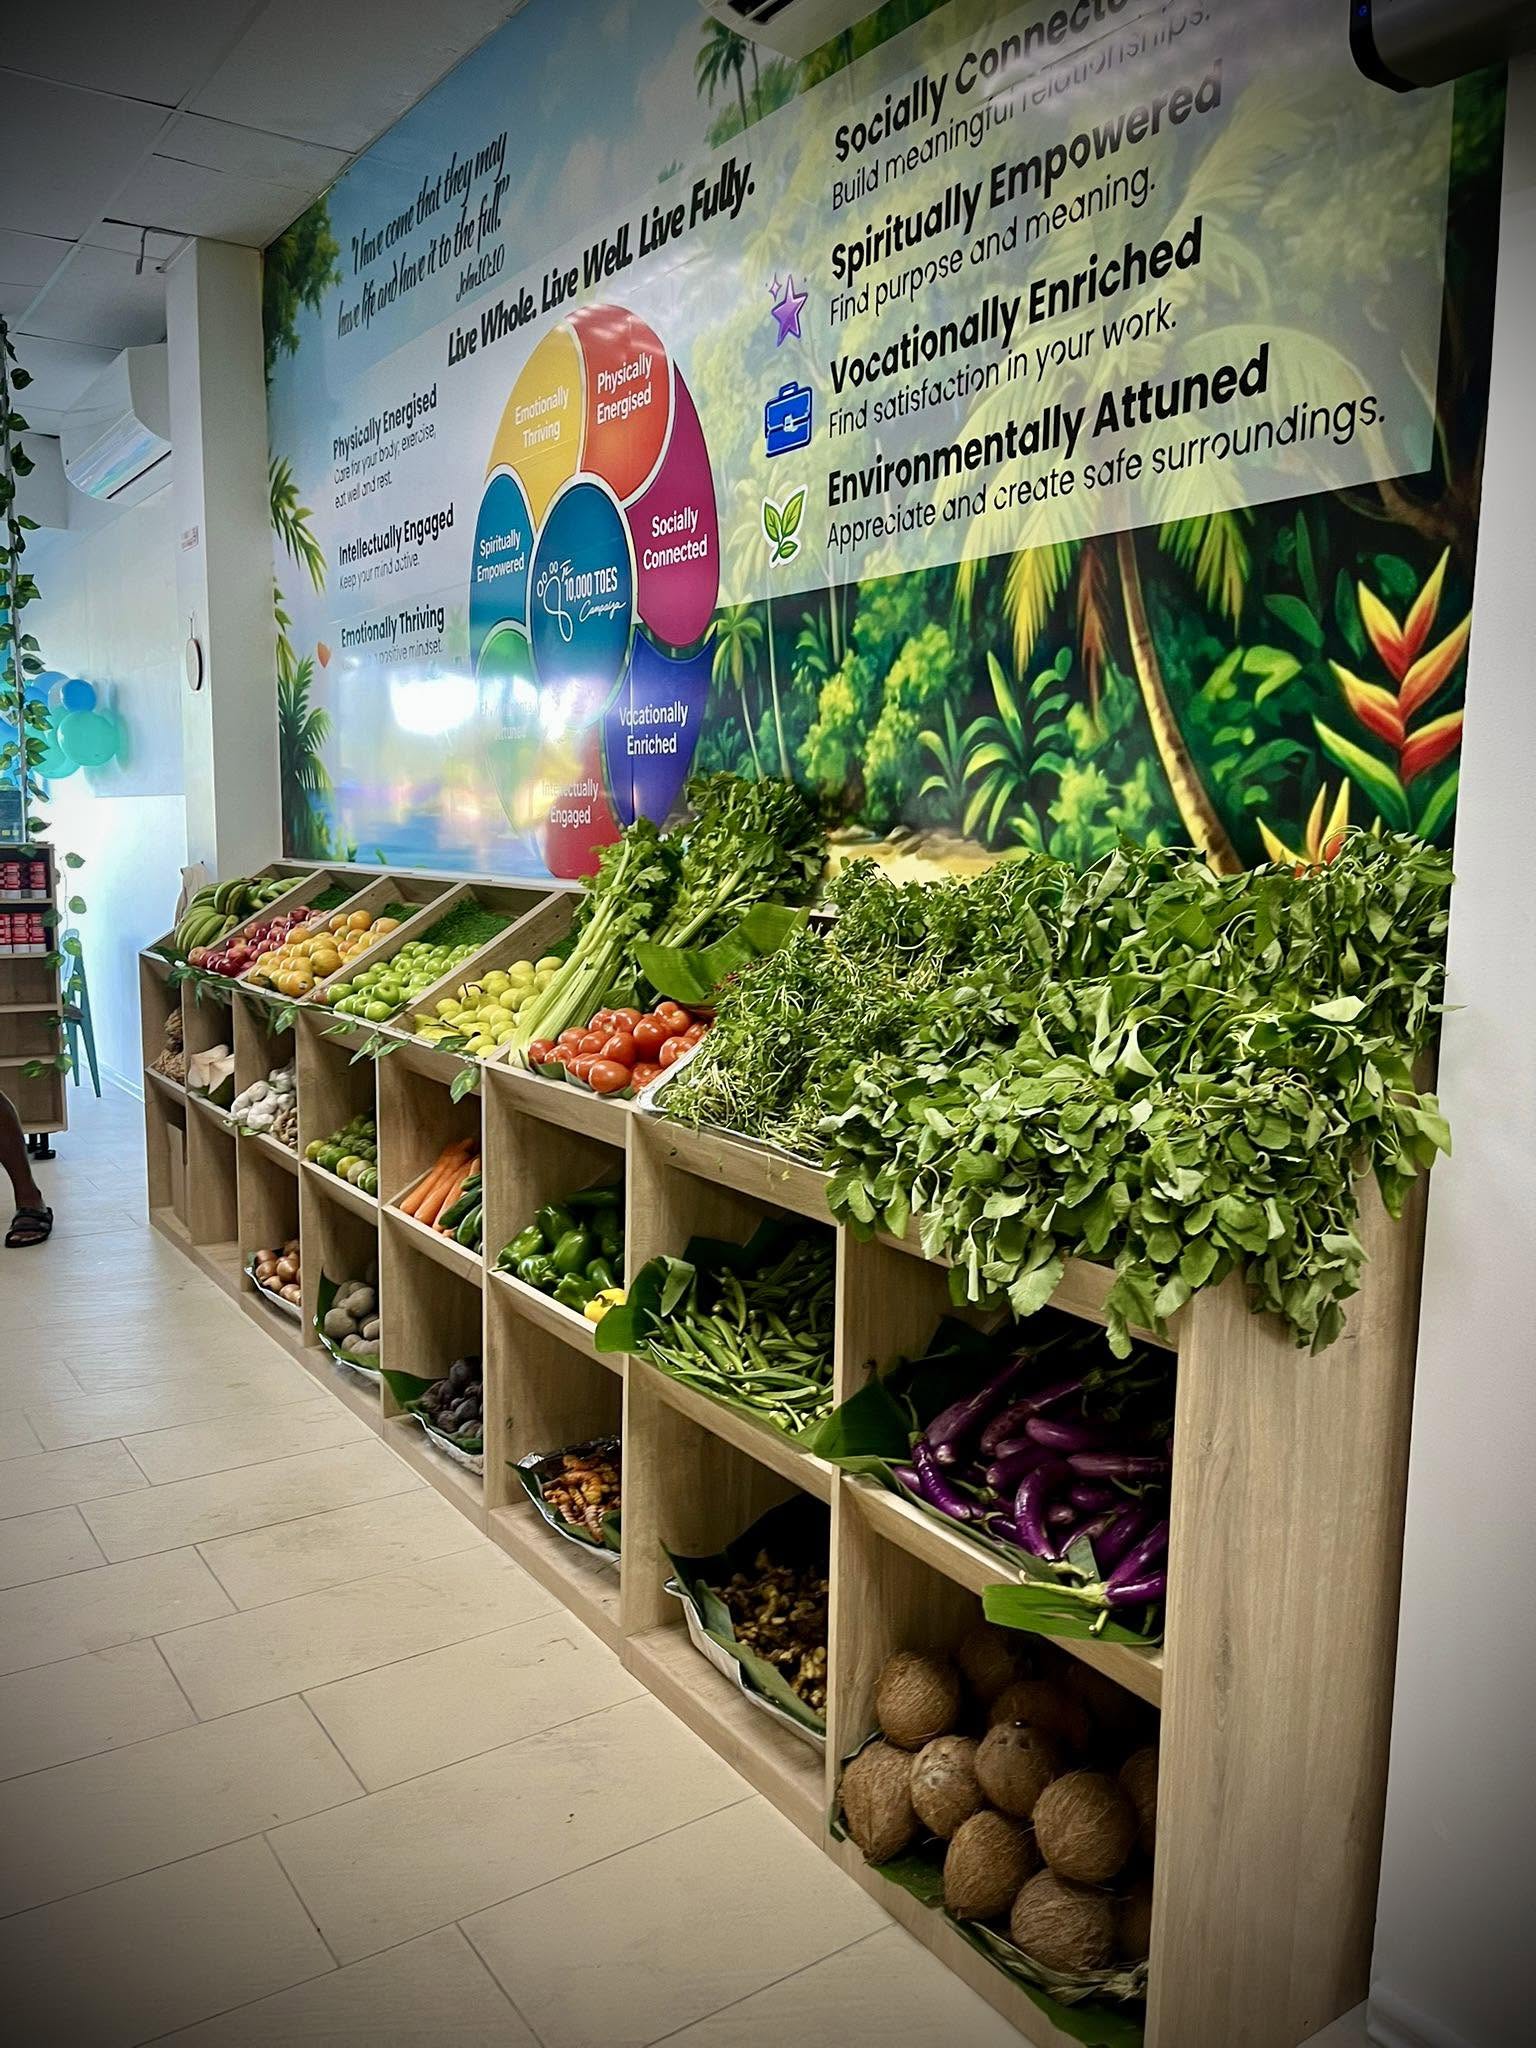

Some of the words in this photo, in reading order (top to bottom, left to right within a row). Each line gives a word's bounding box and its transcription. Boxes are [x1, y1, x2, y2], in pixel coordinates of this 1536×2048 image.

[835, 73, 948, 162] Socially
[832, 161, 880, 210] Build
[886, 86, 1014, 182] meaningful
[832, 176, 983, 287] Spiritually
[990, 59, 1223, 209] Empowered
[360, 228, 383, 270] have
[385, 205, 414, 249] come
[417, 175, 441, 225] that
[444, 152, 473, 207] they
[474, 132, 507, 182] may
[448, 327, 477, 367] Live
[481, 287, 537, 348] Whole.
[541, 267, 578, 314] Live
[583, 222, 634, 289] Well.
[639, 206, 685, 258] Live
[689, 156, 755, 230] Fully.
[831, 283, 869, 326] Find
[876, 245, 963, 317] purpose
[970, 216, 1018, 264] and
[1025, 166, 1156, 243] meaning.
[338, 299, 360, 340] have
[362, 279, 376, 330] life
[378, 260, 397, 311] and
[400, 252, 425, 296] have
[428, 238, 437, 275] it
[439, 233, 451, 268] to
[453, 206, 475, 257] the
[830, 295, 1021, 394] Vocationally
[1029, 216, 1203, 325] Enriched
[597, 351, 653, 394] Physically
[829, 400, 867, 438] Find
[873, 362, 999, 425] satisfaction
[1007, 349, 1028, 382] in
[1036, 328, 1095, 382] your
[1102, 297, 1177, 349] work.
[333, 417, 381, 461] Physically
[383, 383, 437, 433] Energised
[515, 385, 569, 425] Emotionally
[596, 382, 652, 425] Energised
[828, 404, 1086, 506] Environmentally
[1092, 342, 1270, 437] Attuned
[522, 420, 561, 448] Thriving
[827, 502, 936, 555] Appreciate
[943, 484, 987, 521] and
[994, 468, 1074, 510] create
[1083, 448, 1142, 490] safe
[1152, 395, 1385, 475] surroundings.
[339, 524, 402, 566] Intellectually
[404, 502, 454, 546] Engaged
[480, 528, 521, 559] Spiritually
[651, 506, 699, 538] Socially
[477, 551, 525, 583] Empowered
[643, 533, 708, 570] Connected
[340, 574, 356, 592] Keep
[564, 572, 593, 603] 10,000
[595, 566, 618, 595] TOES
[341, 615, 398, 648] Emotionally
[399, 604, 445, 633] Thriving
[619, 700, 688, 728] Vocationally
[627, 732, 677, 755] Enriched
[550, 805, 591, 828] Engaged
